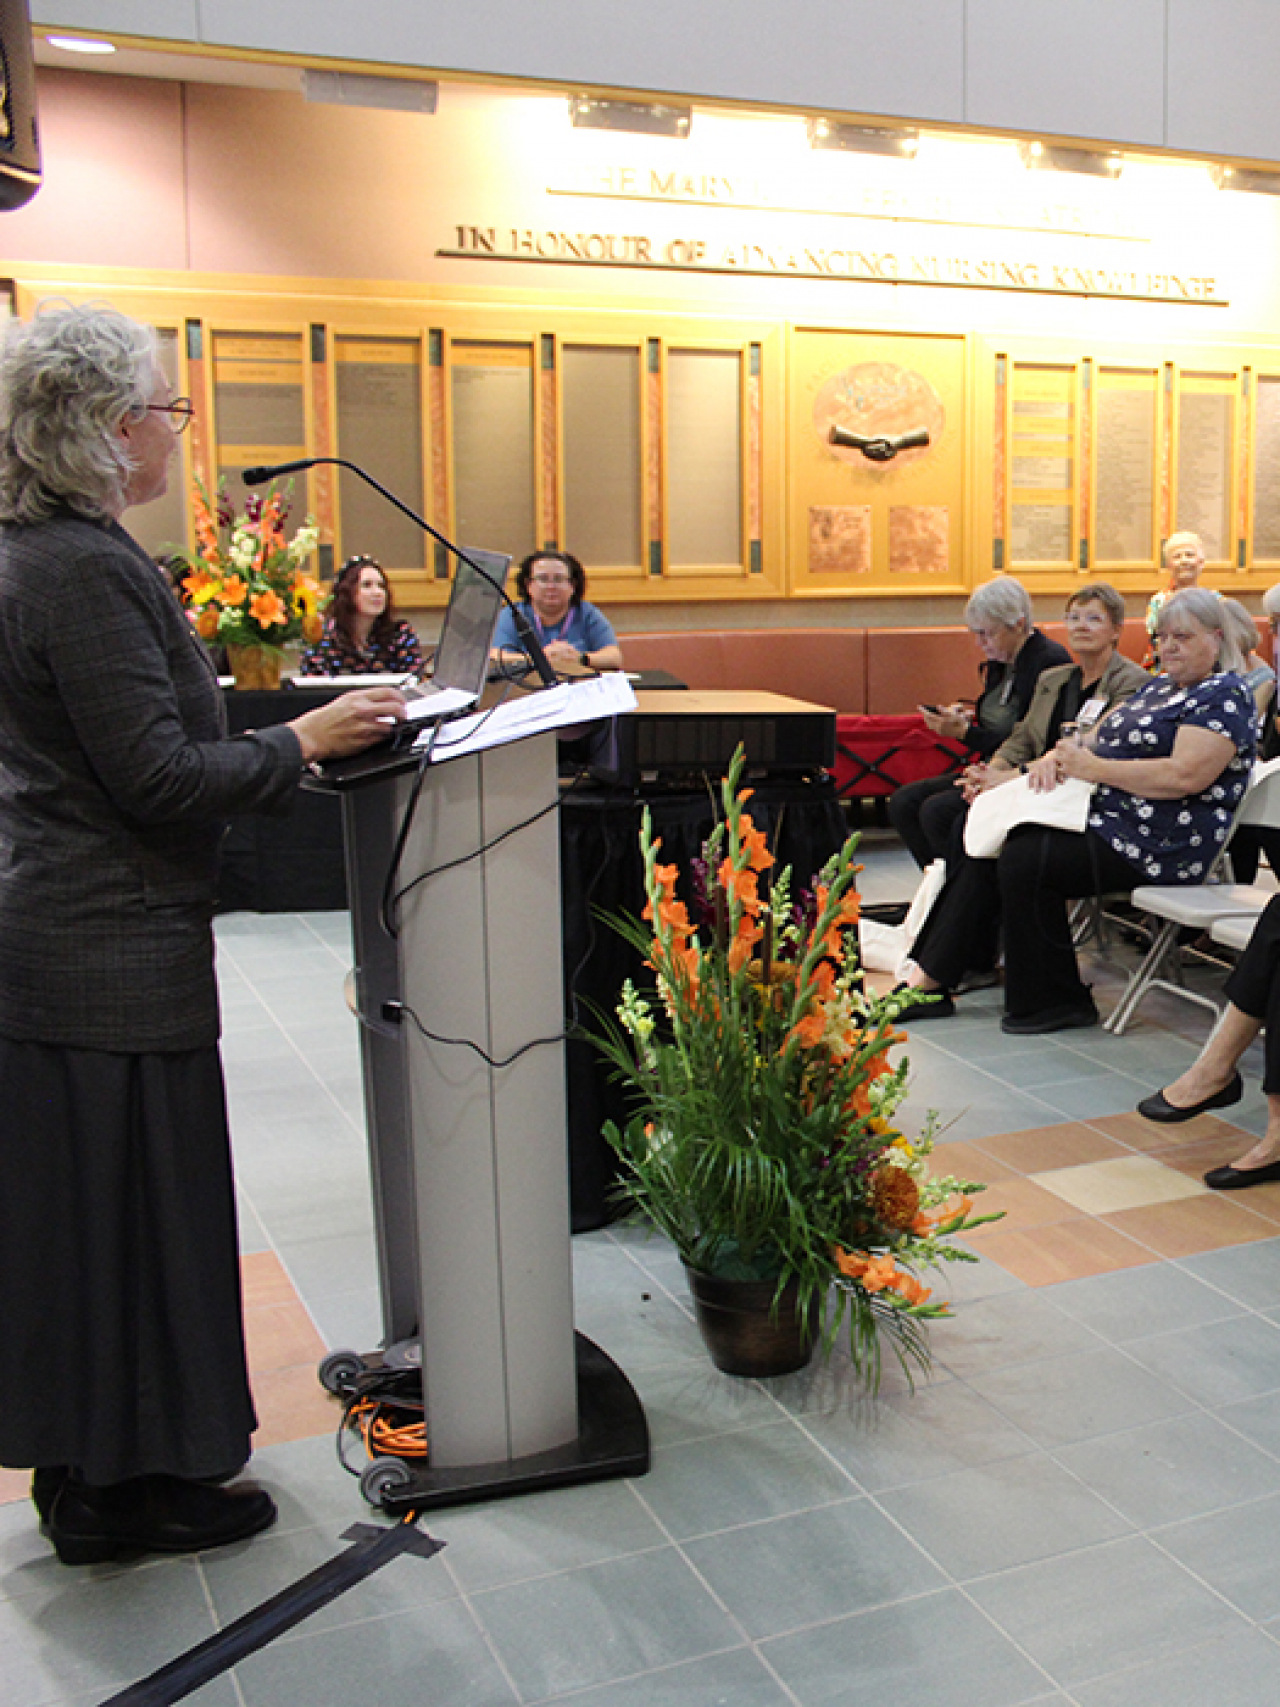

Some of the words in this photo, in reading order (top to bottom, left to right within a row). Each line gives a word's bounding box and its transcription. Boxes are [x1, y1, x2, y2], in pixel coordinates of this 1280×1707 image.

[455, 225, 497, 252] IN
[510, 228, 651, 263] HONOUR
[665, 237, 707, 263] OF
